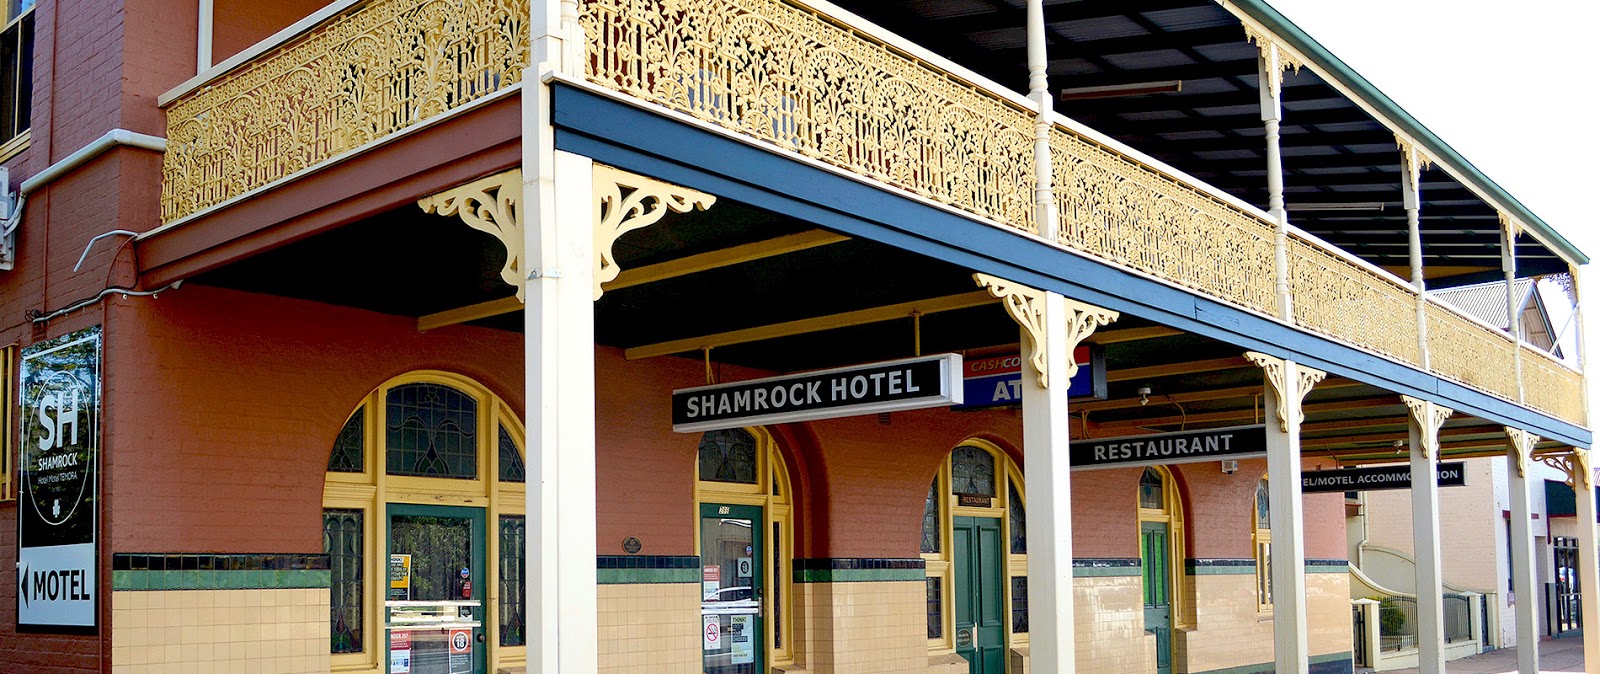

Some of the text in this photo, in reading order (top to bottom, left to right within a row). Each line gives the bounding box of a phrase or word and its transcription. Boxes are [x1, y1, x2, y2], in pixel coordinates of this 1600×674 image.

[971, 356, 1022, 373] CASHCO
[686, 369, 920, 418] SHAMROCK HOTEL
[992, 379, 1022, 402] AT
[39, 387, 78, 451] SH
[1094, 434, 1234, 461] RESTAURANT
[38, 452, 78, 471] SHAMROCK
[1302, 475, 1354, 487] EL/MOTEL
[963, 496, 990, 504] RESTAURANT
[34, 569, 91, 602] MOTEL
[456, 638, 465, 648] 18
